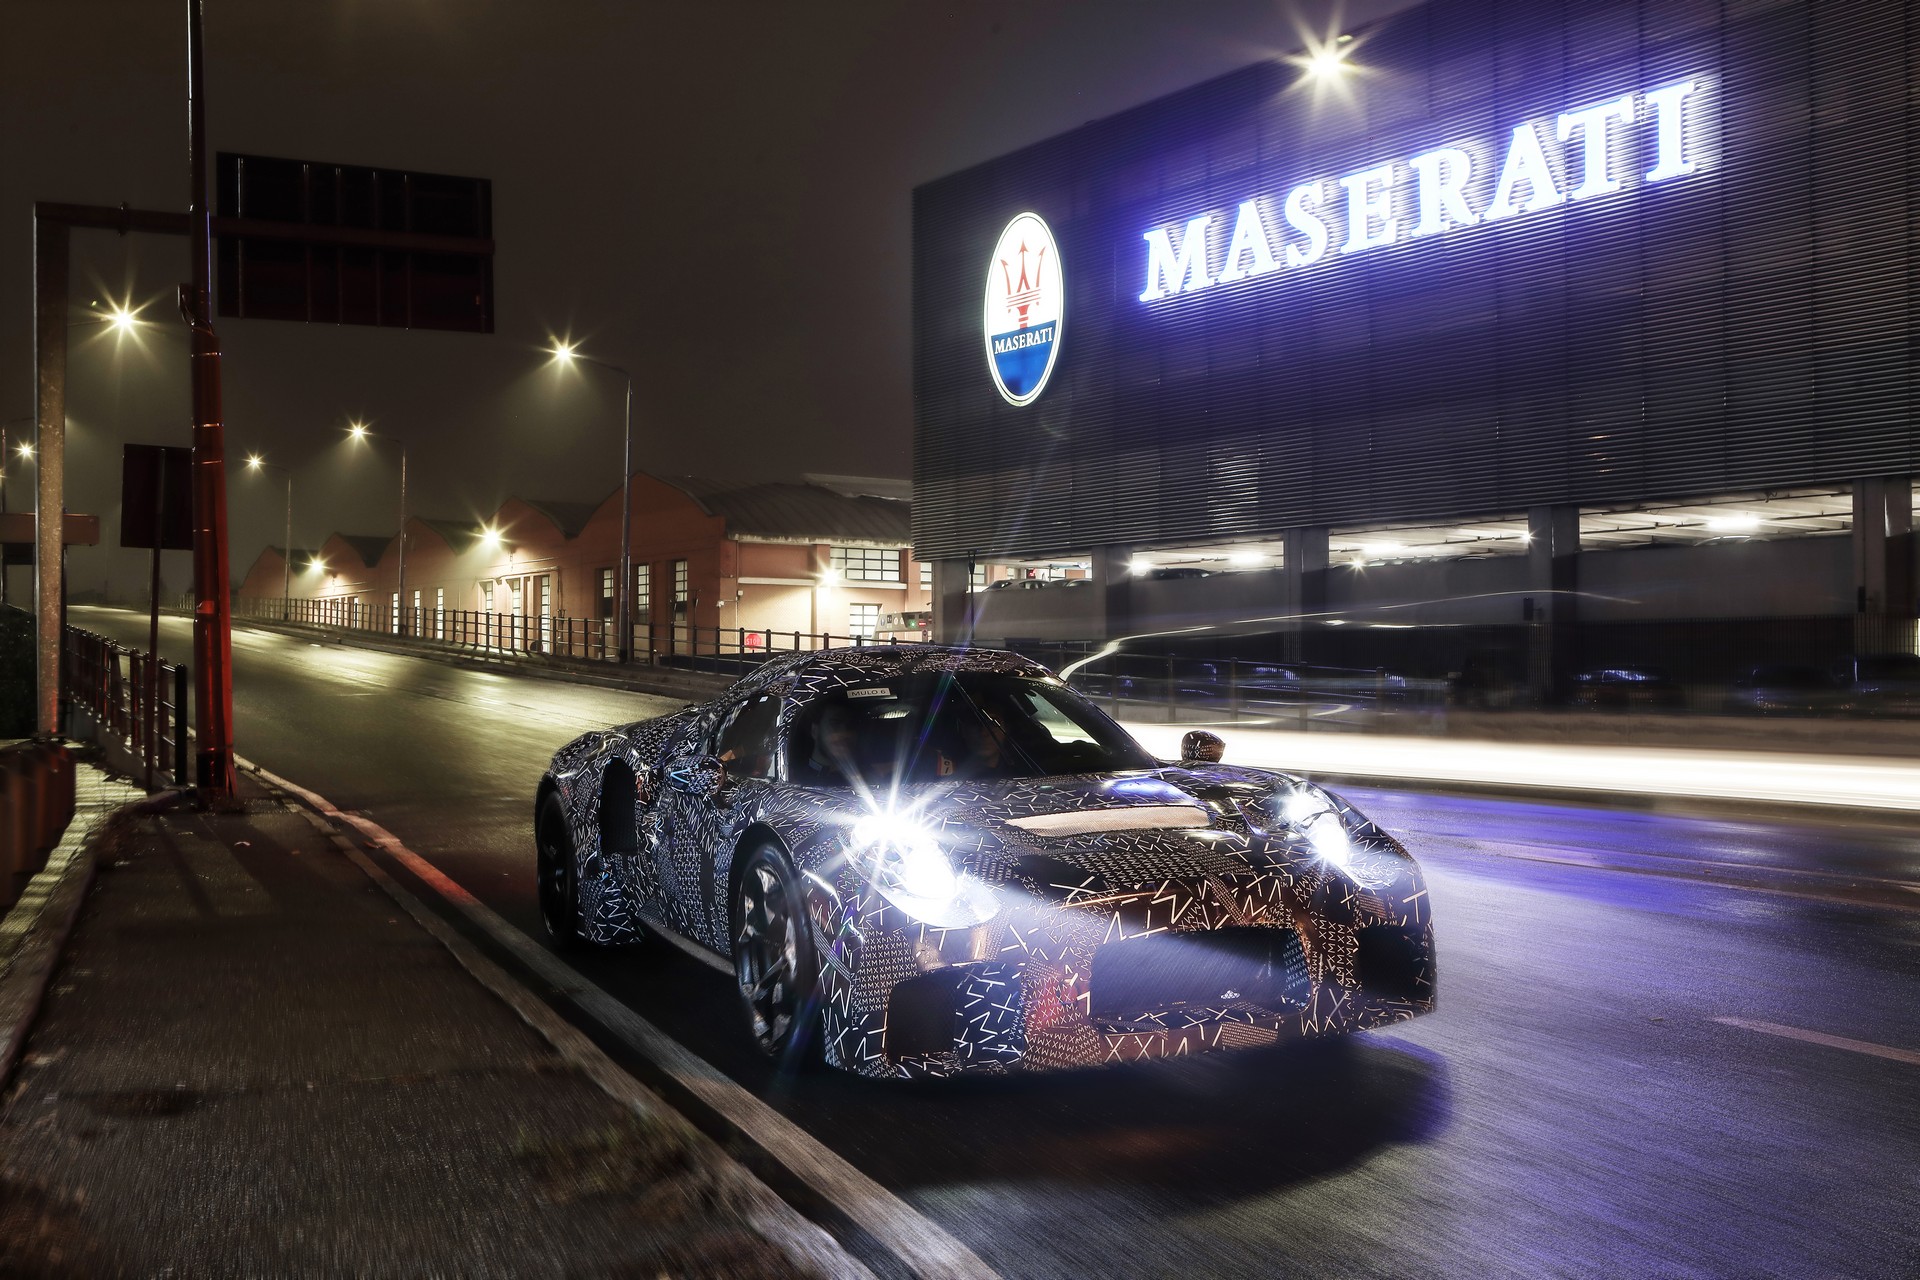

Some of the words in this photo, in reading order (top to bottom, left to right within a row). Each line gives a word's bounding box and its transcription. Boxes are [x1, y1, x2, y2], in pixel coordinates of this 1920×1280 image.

[1139, 81, 1695, 302] MASERATI
[994, 326, 1053, 355] MASERATI
[851, 689, 878, 697] MULO
